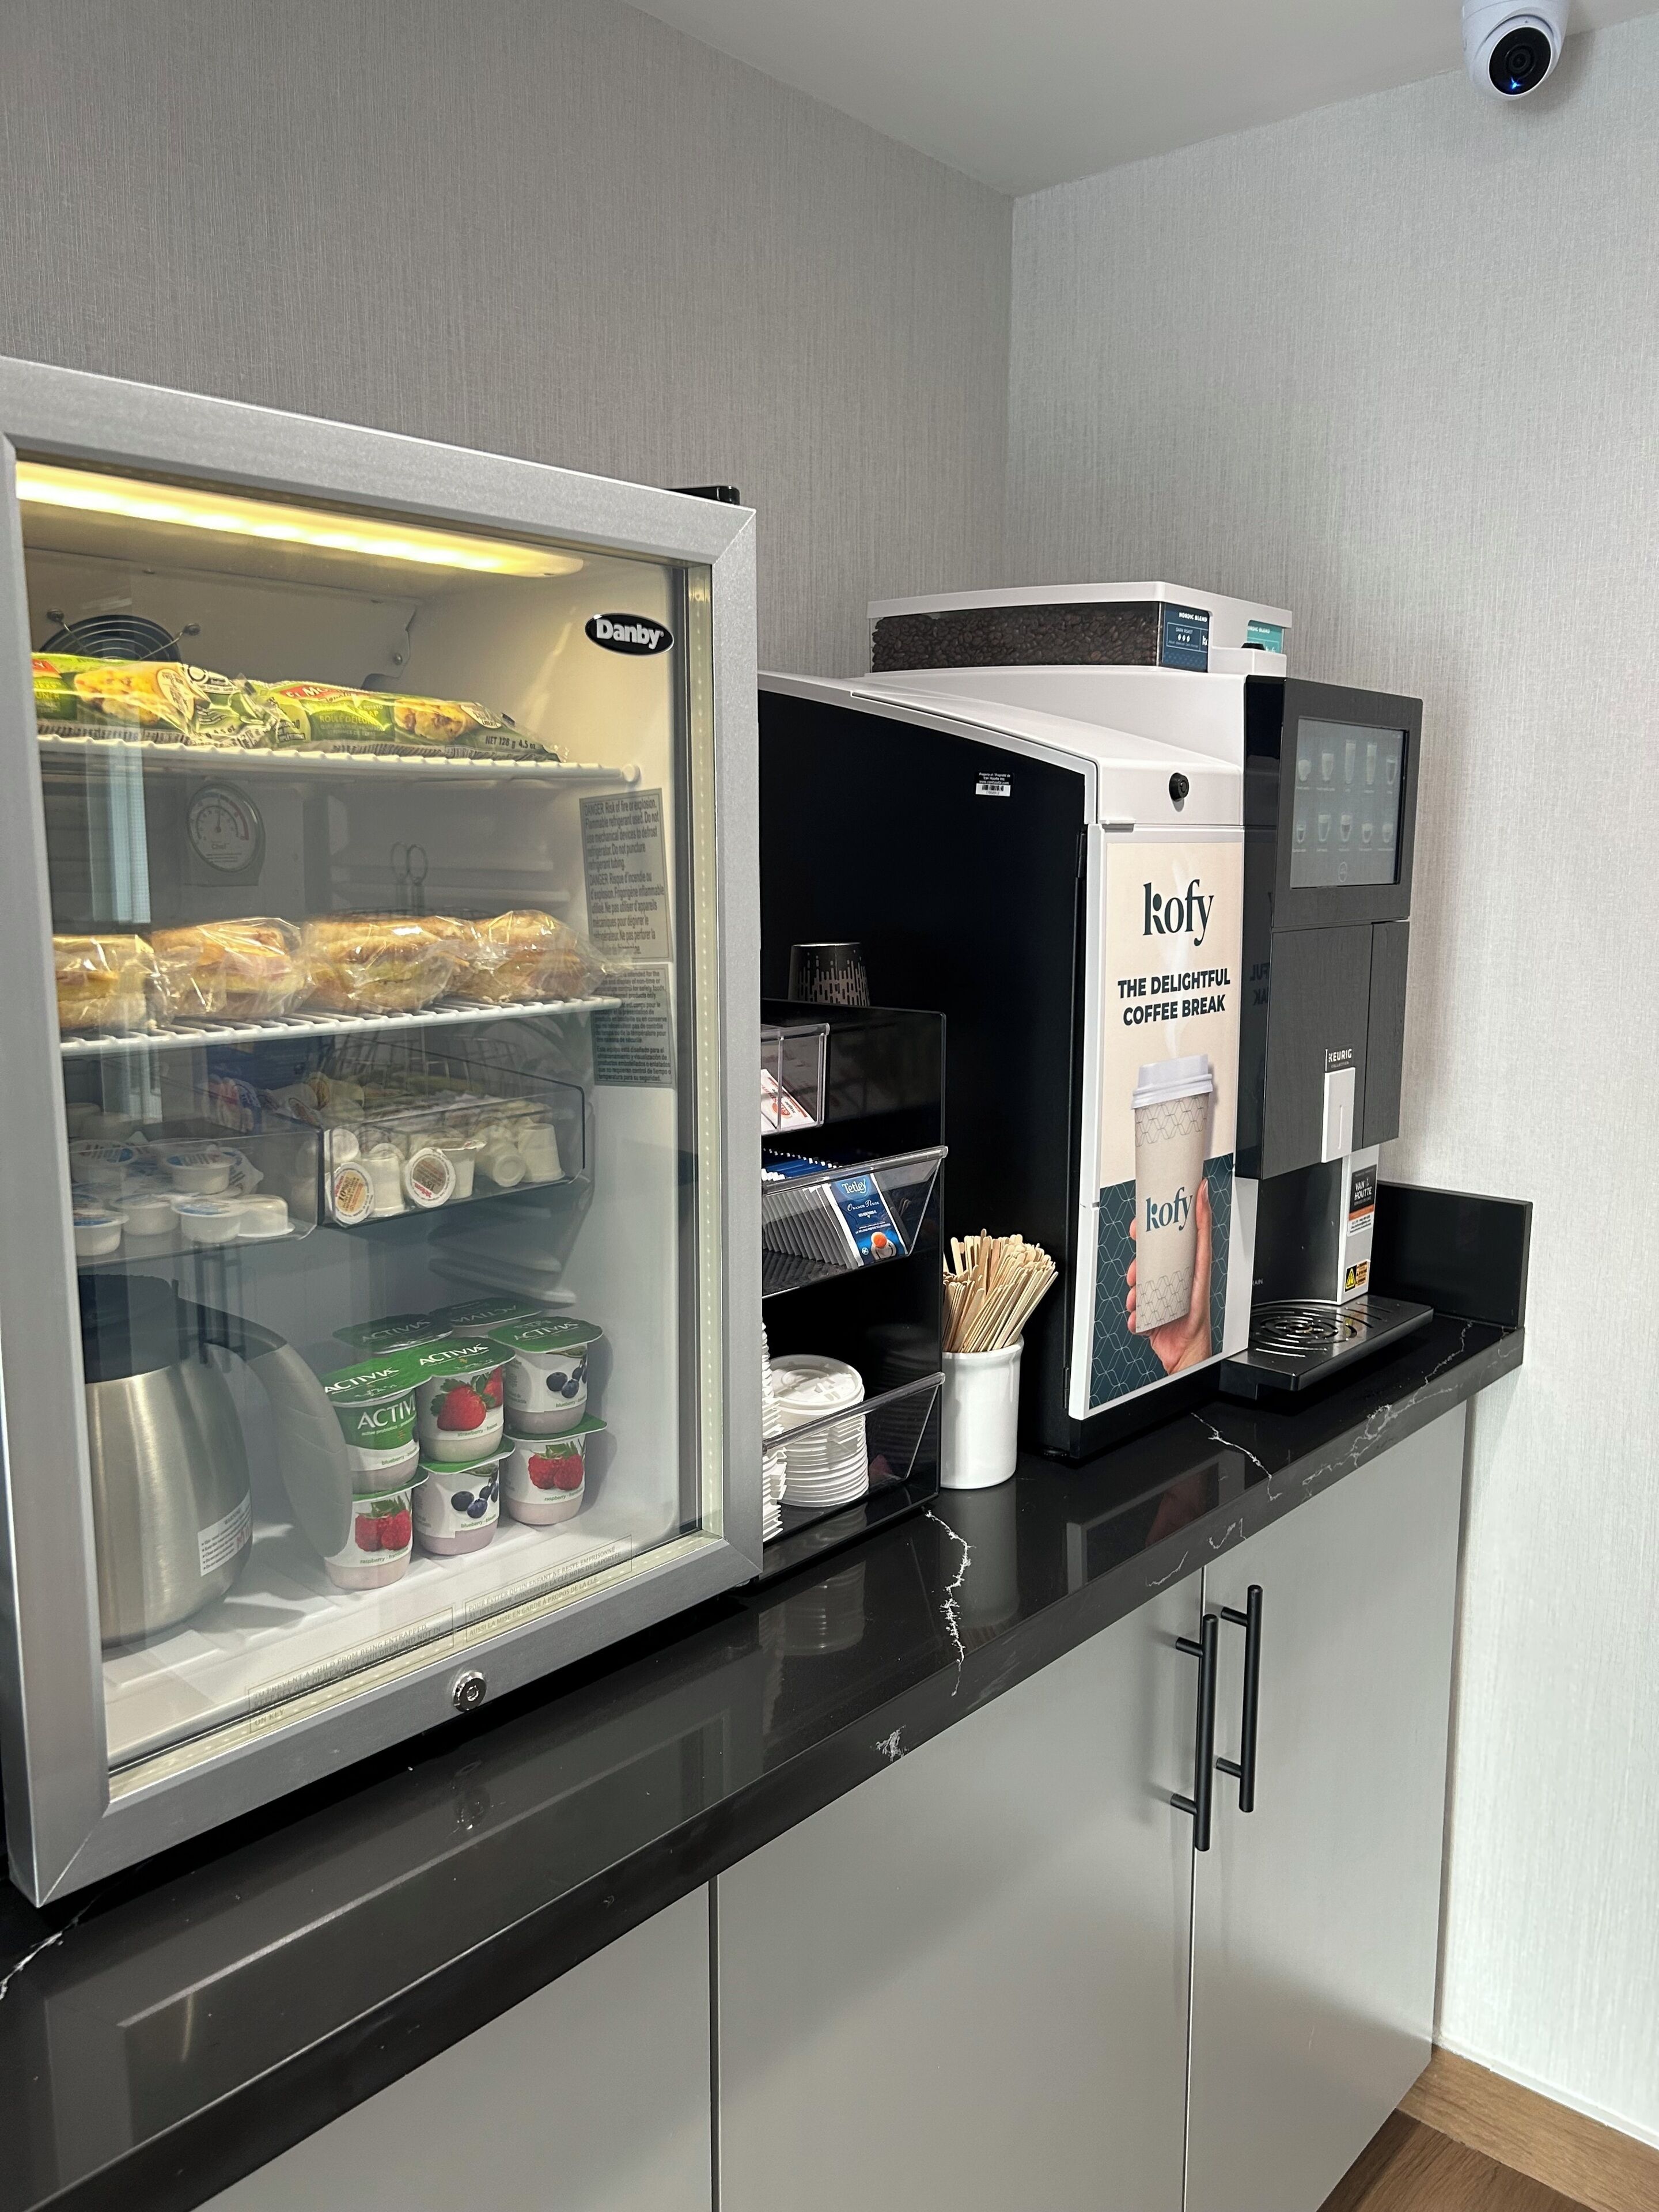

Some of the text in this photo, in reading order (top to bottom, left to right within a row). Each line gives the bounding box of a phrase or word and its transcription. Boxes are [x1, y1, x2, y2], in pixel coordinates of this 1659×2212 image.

[1179, 612, 1194, 620] NORDIC
[596, 619, 661, 650] Danby
[485, 736, 497, 745] NET
[499, 737, 510, 746] 128
[518, 739, 528, 748] 4.5
[1143, 879, 1214, 946] kofy
[1118, 968, 1230, 999] THE DELIGHTFUL
[1123, 994, 1226, 1026] COFFEE BREAK
[1328, 1048, 1353, 1063] KEURIG
[842, 1179, 866, 1194] Tetley
[1355, 1180, 1365, 1191] VAN
[1354, 1187, 1372, 1201] HOUTTE
[1146, 1186, 1193, 1232] kofy
[362, 1319, 431, 1343] ACTIVIA
[514, 1322, 578, 1340] ACTIVIA
[419, 1343, 488, 1366] ACTIVIA
[325, 1368, 400, 1393] ACTIVIA
[457, 1428, 484, 1437] strawberry
[461, 1518, 483, 1528] blueberry
[359, 1555, 386, 1565] raspberry
[562, 1559, 579, 1574] RESTE
[496, 1613, 511, 1626] MISE
[548, 1588, 570, 1602] PROPOS
[337, 1651, 359, 1665] FROM
[360, 1642, 383, 1656] BEING
[268, 1708, 285, 1720] KEY
